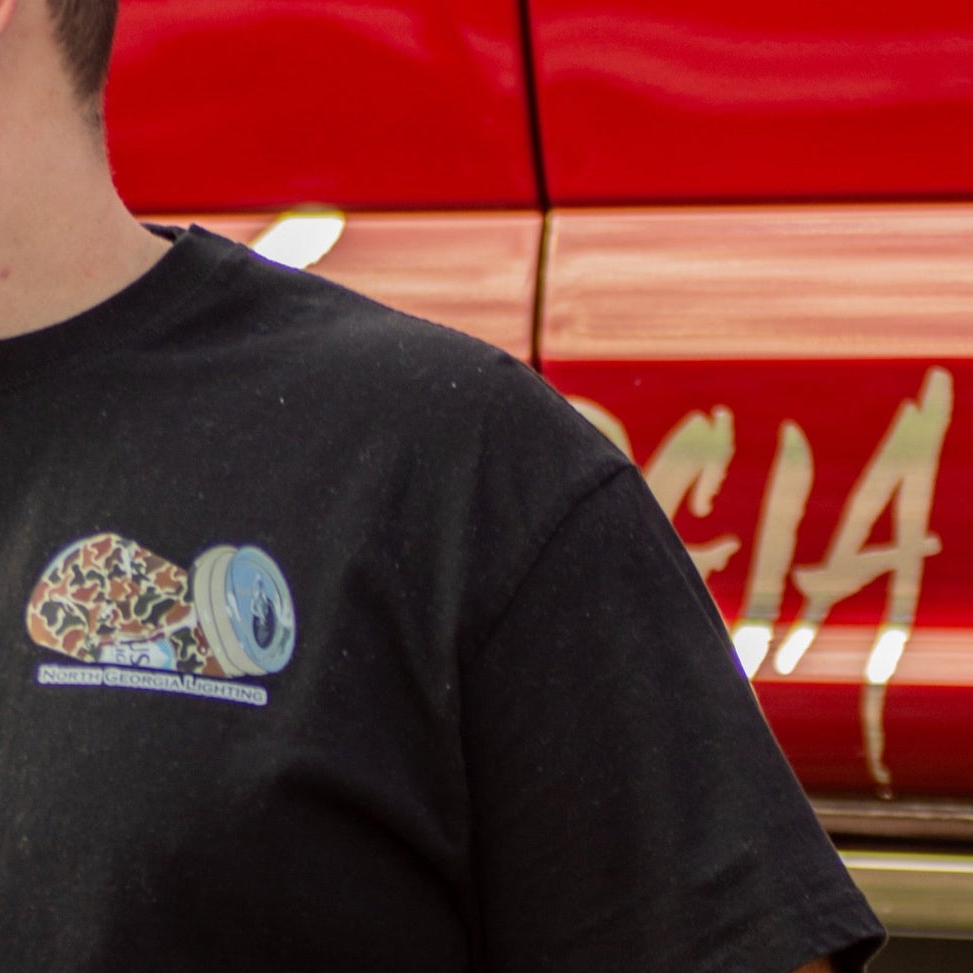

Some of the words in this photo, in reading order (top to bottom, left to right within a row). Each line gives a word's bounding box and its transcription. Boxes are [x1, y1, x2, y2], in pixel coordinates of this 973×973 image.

[41, 667, 101, 684] NORTH
[103, 668, 179, 690] GEORGIA
[184, 676, 265, 703] LIGHTING
